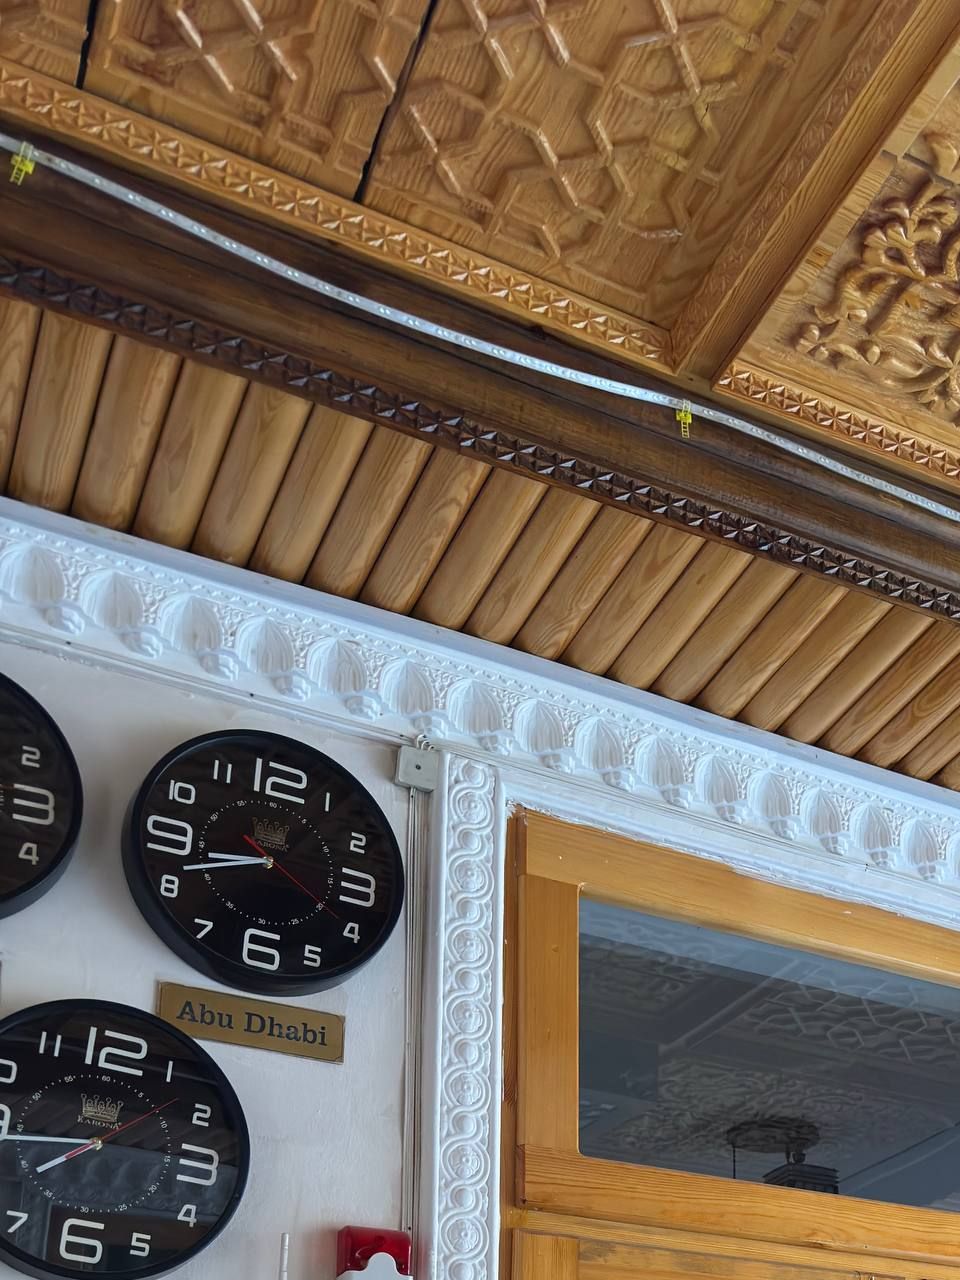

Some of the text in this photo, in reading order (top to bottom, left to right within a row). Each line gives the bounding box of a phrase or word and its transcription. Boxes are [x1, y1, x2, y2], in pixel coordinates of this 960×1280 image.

[21, 745, 41, 768] 2
[213, 759, 233, 784] 11
[253, 757, 308, 804] 12
[12, 783, 55, 825] 3
[168, 779, 196, 805] 10
[324, 792, 331, 812] 1
[146, 815, 193, 856] 9
[349, 832, 367, 854] 2
[18, 842, 39, 865] 4
[160, 874, 179, 898] 8
[339, 867, 376, 908] 3
[194, 918, 214, 939] 7
[343, 922, 360, 944] 4
[242, 928, 281, 971] 6
[303, 944, 322, 968] 5
[176, 1000, 328, 1046] Abu Dhabi
[39, 1031, 62, 1057] 11
[84, 1026, 149, 1076] 12
[0, 1058, 18, 1084] 0
[166, 1060, 173, 1083] 1
[32, 1092, 41, 1101] 50
[160, 1120, 168, 1129] 10
[191, 1103, 212, 1127] 2
[176, 1143, 220, 1186] 3
[80, 1206, 89, 1214] 30
[118, 1203, 128, 1211] 25
[177, 1204, 197, 1228] 4
[6, 1209, 29, 1233] 7
[59, 1218, 105, 1264] 6
[129, 1232, 151, 1257] 5
